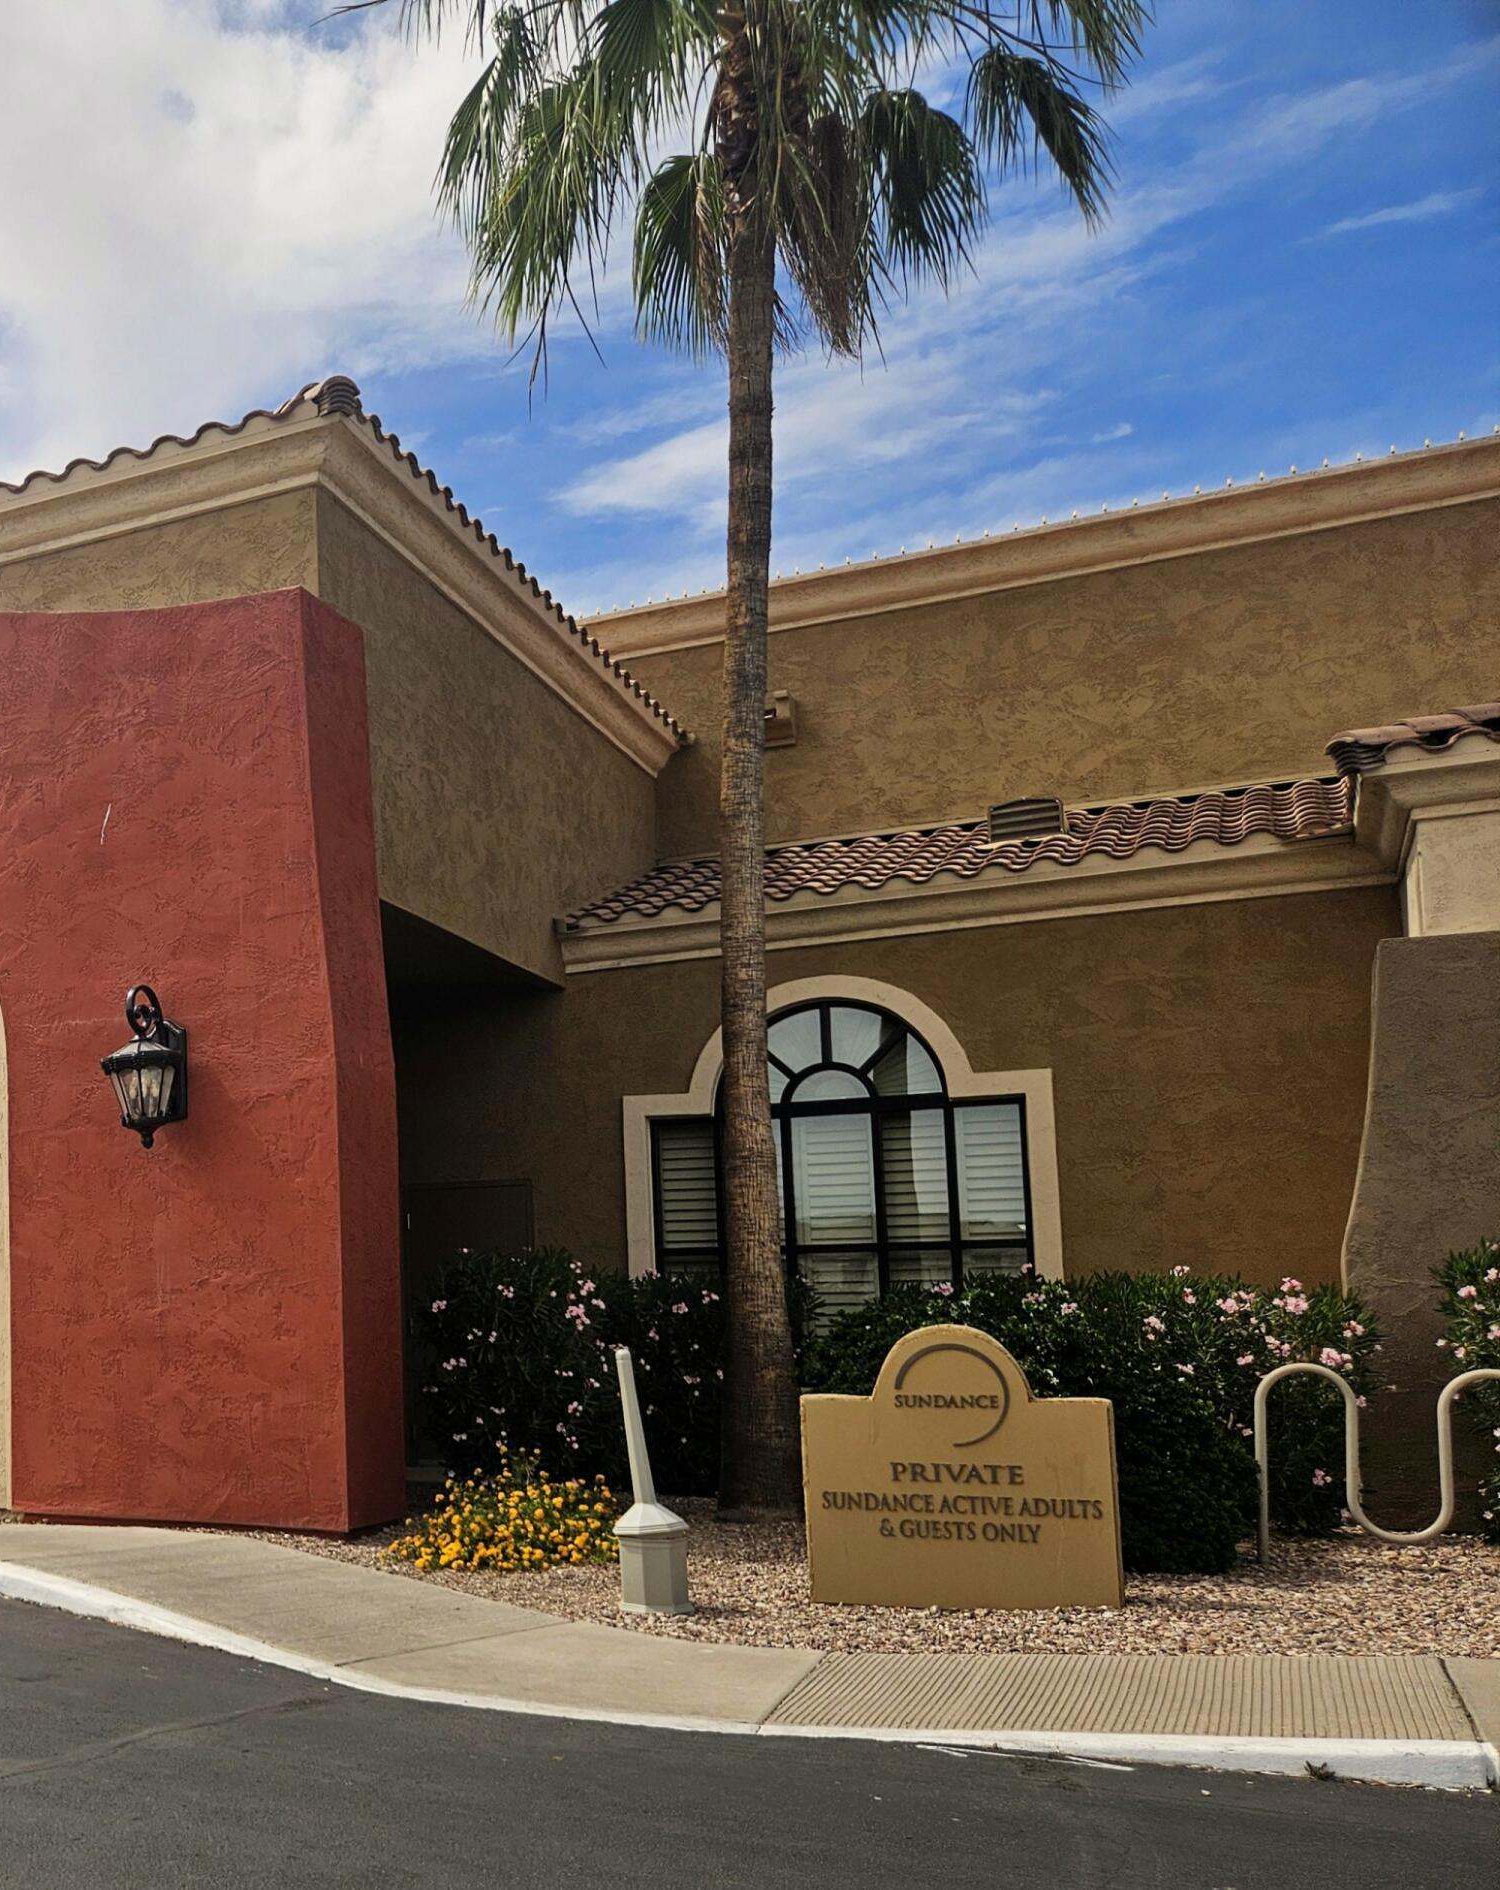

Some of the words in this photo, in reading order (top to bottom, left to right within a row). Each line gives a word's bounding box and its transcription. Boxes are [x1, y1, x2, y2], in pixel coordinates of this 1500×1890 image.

[894, 1394, 999, 1409] SUNDANCE
[890, 1462, 1024, 1485] PRIVATE
[821, 1491, 934, 1513] SUNDANCE
[939, 1495, 1014, 1516] ACTIVE
[1019, 1498, 1103, 1520] ADULTS
[879, 1518, 895, 1537] &
[899, 1519, 976, 1541] GUESTS
[982, 1523, 1041, 1544] ONLY
